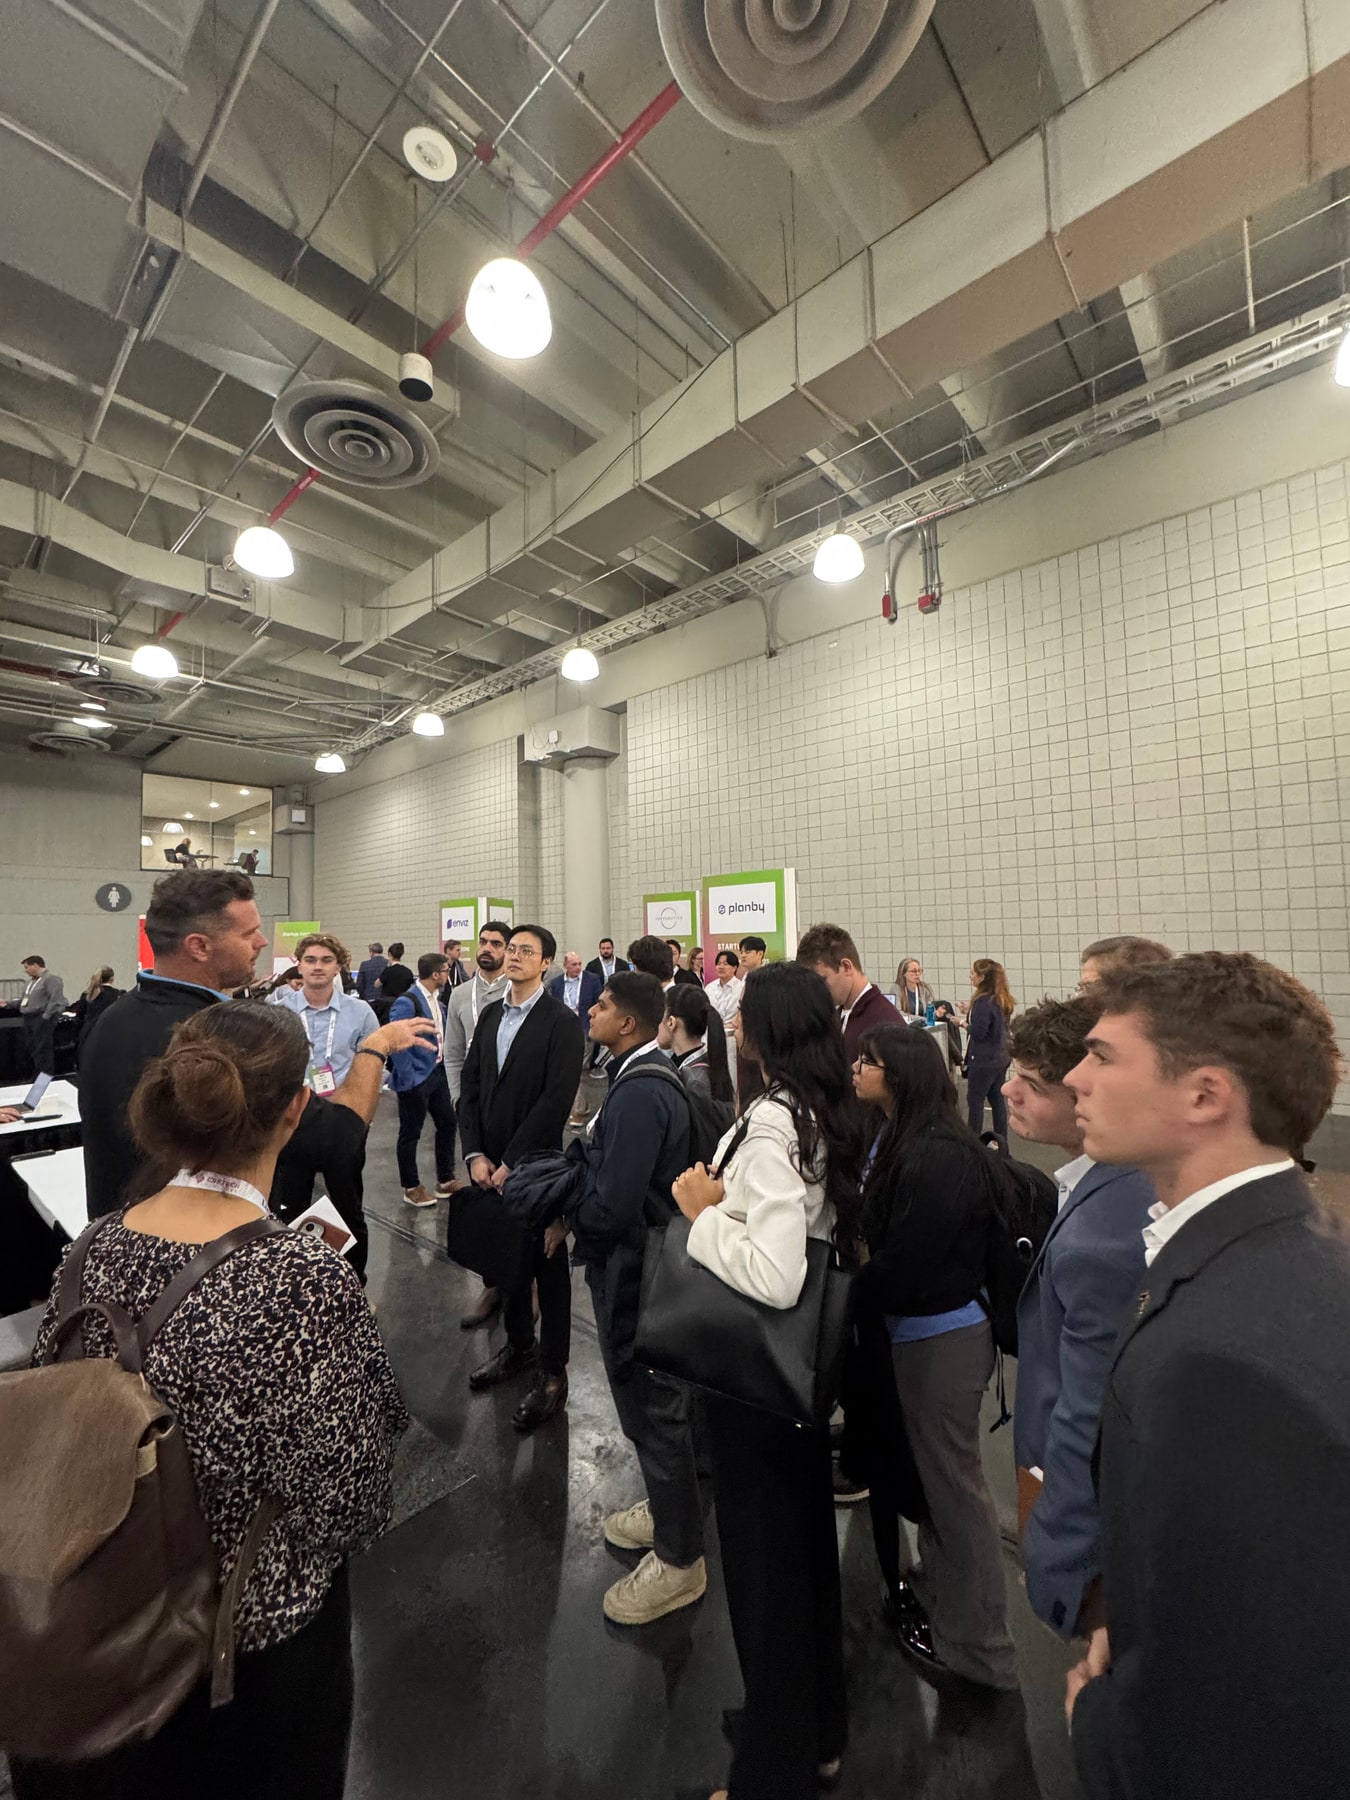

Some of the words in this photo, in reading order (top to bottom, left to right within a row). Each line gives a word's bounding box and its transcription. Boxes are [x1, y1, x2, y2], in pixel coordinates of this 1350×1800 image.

[728, 901, 765, 915] planby
[453, 919, 469, 928] enviz
[717, 943, 740, 951] STARTU
